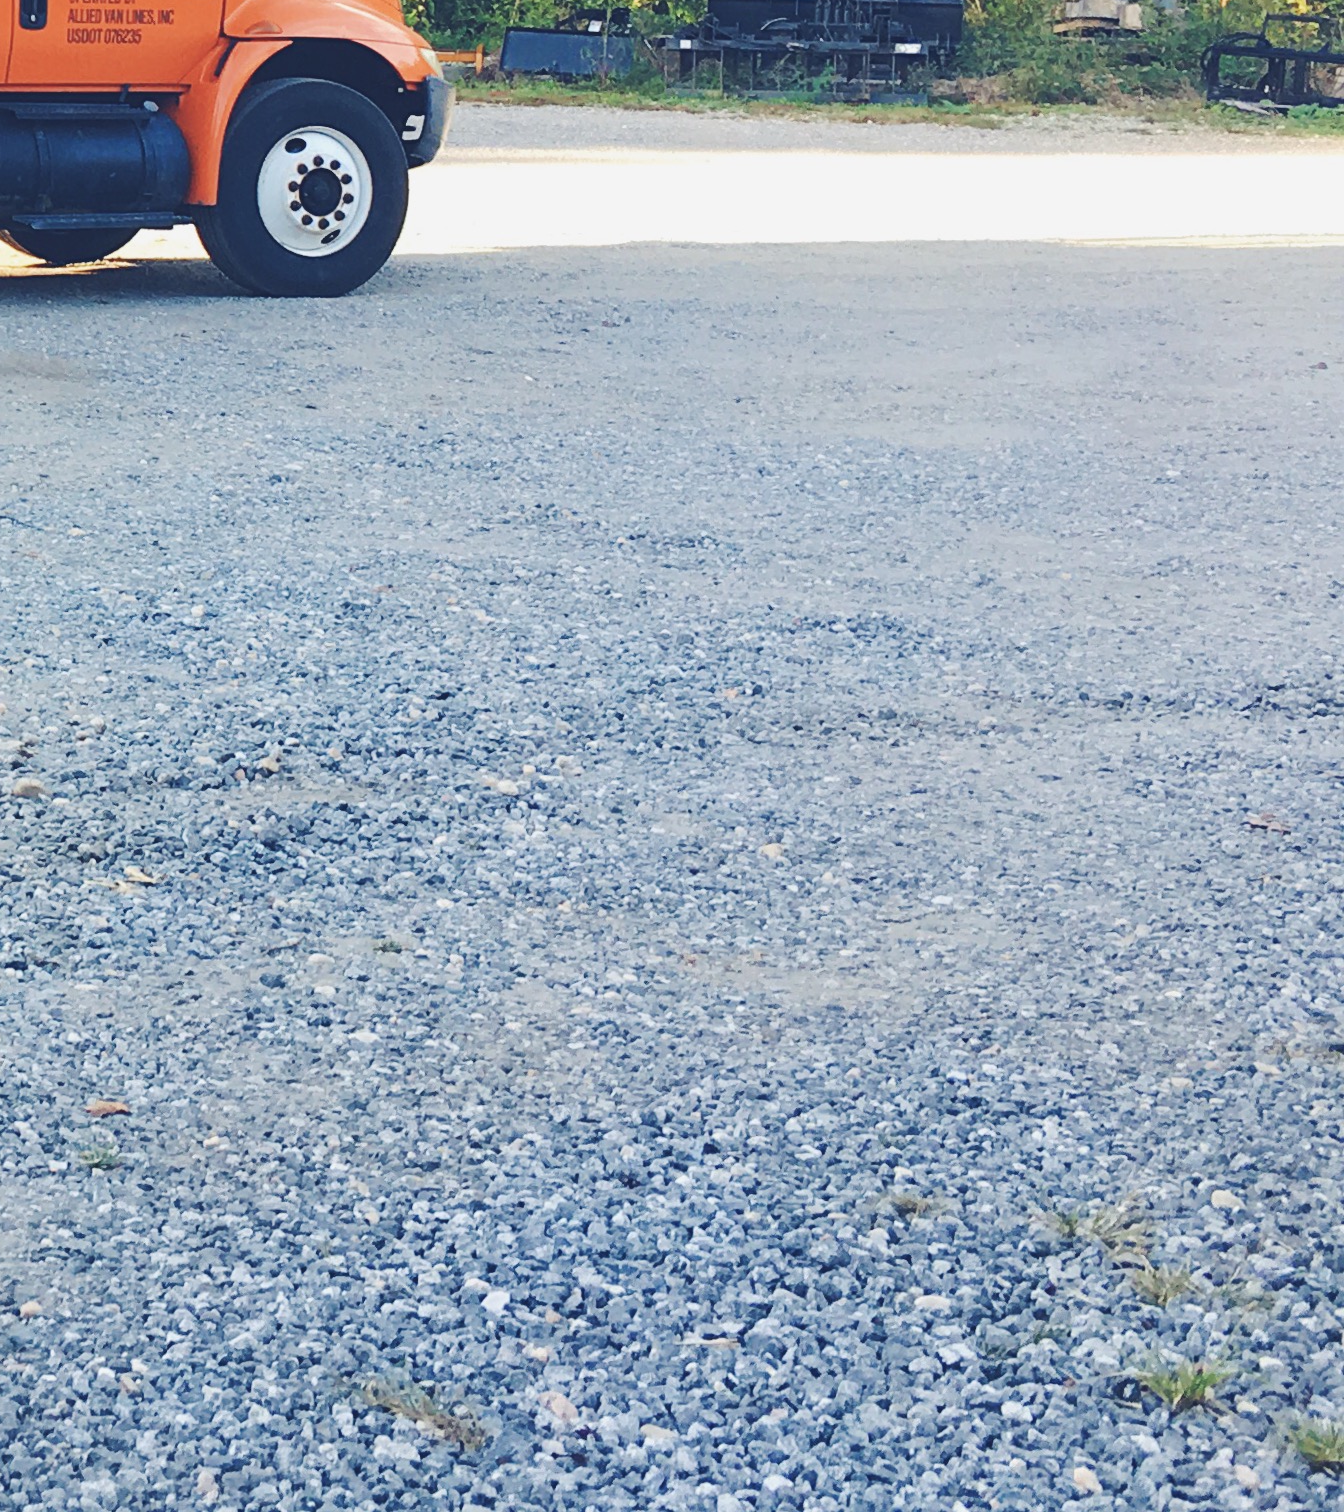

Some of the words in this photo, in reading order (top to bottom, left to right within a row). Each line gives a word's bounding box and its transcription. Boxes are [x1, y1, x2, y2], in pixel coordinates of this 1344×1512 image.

[67, 8, 102, 24] ALLIED
[104, 9, 123, 24] VAN
[126, 9, 156, 26] LINES,
[157, 9, 175, 25] INC
[66, 28, 103, 44] USDOT
